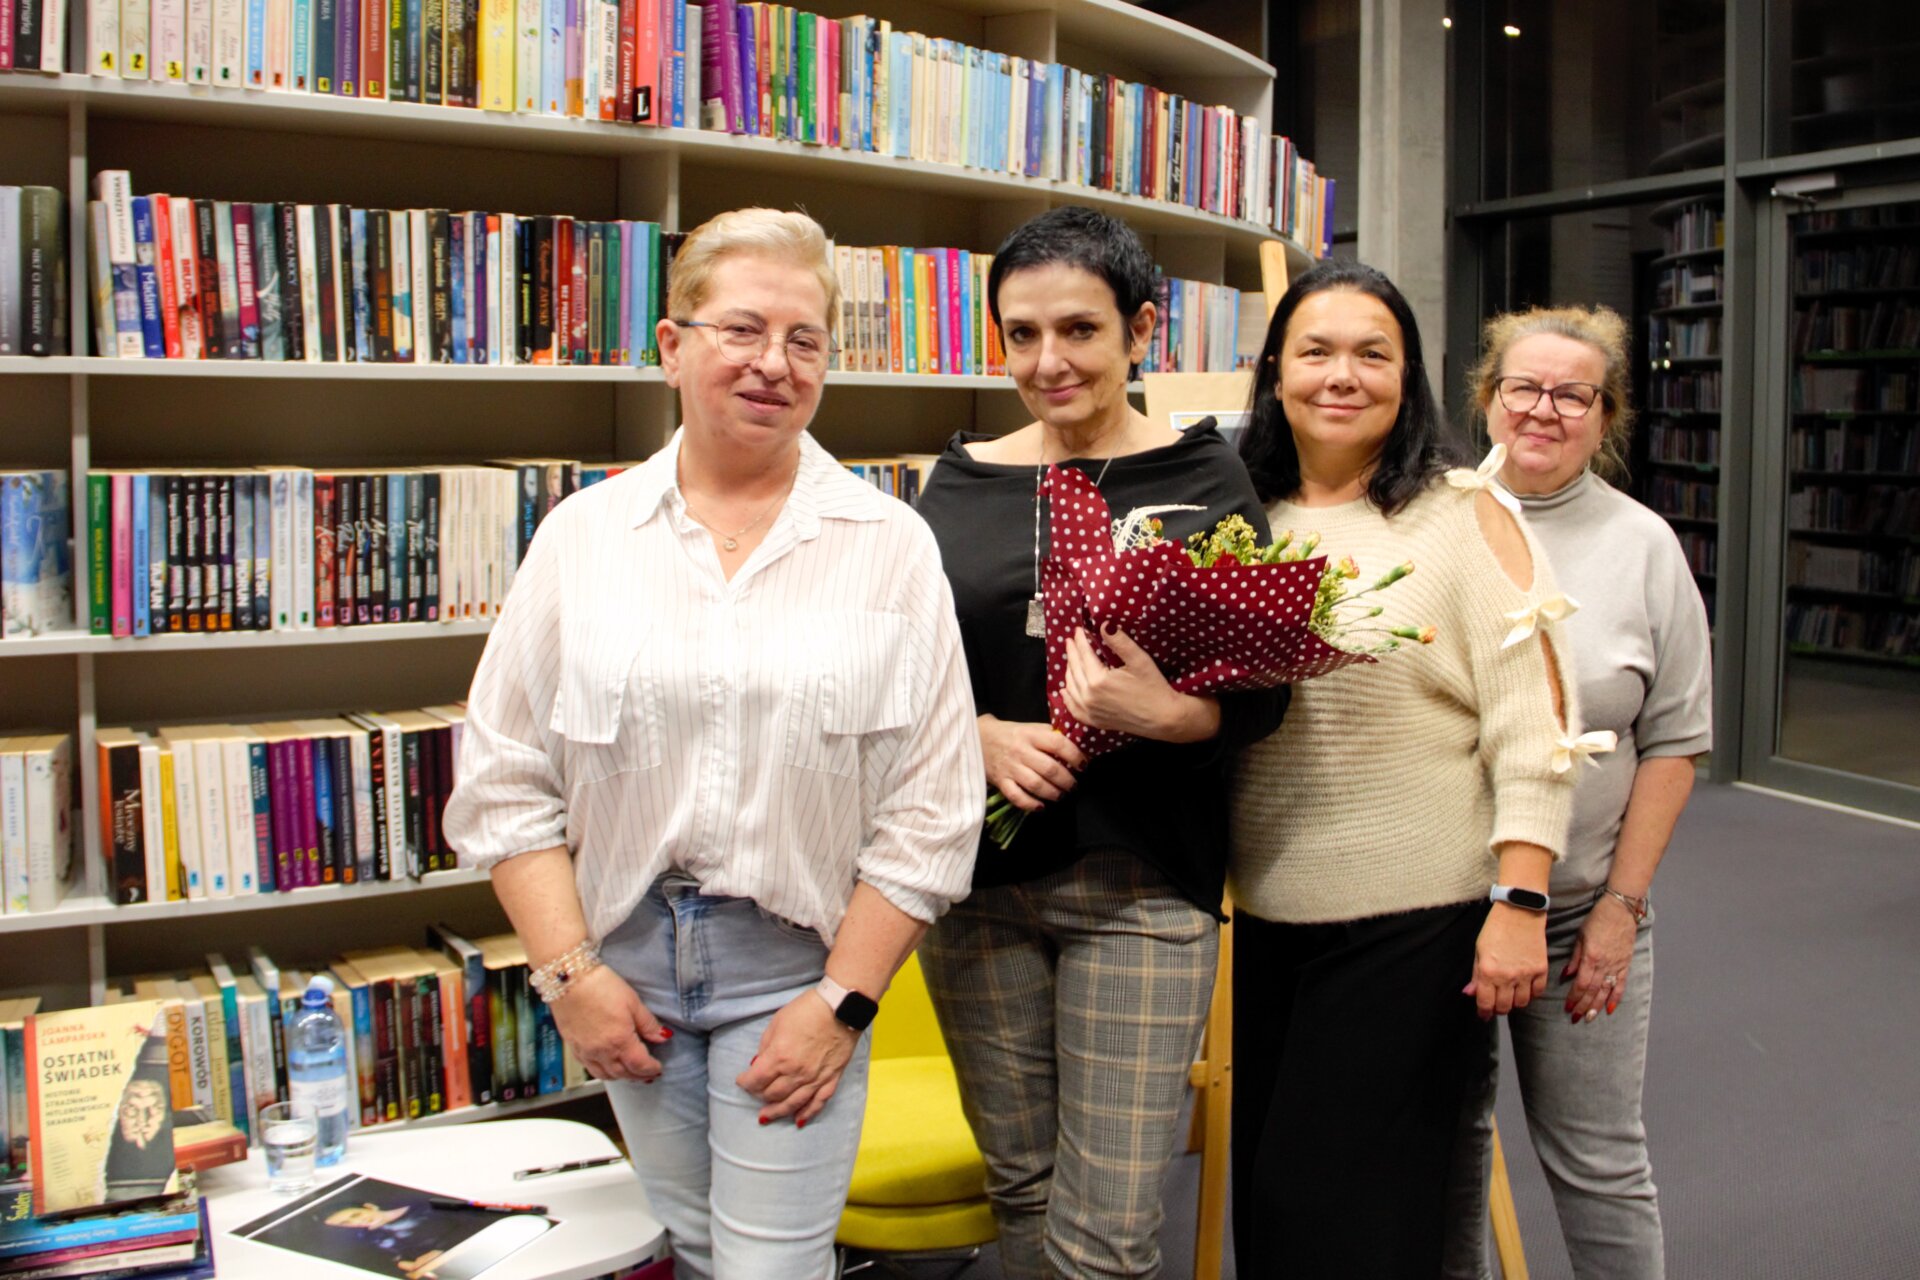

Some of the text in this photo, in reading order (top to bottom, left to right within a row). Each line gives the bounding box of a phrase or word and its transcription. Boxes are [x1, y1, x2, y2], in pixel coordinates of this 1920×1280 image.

[31, 247, 43, 269] NIKT
[32, 284, 43, 297] NIE
[142, 271, 157, 320] Madame
[560, 284, 569, 299] BEZ
[32, 299, 43, 335] UWIERZY
[524, 502, 535, 539] 365 dni
[150, 560, 163, 609] TAJFUN
[371, 735, 384, 783] CENA
[123, 788, 142, 853] Mroczny
[376, 823, 389, 874] Waldemar
[41, 1032, 106, 1046] LAMPARSKA
[42, 1023, 85, 1036] JOANNA
[167, 1011, 187, 1075] DYGOT
[43, 1049, 116, 1069] OSTATNI
[190, 1015, 209, 1089] KOROWÓD
[43, 1062, 123, 1084] ŚWIADEK
[45, 1115, 86, 1127] SKARBÓW
